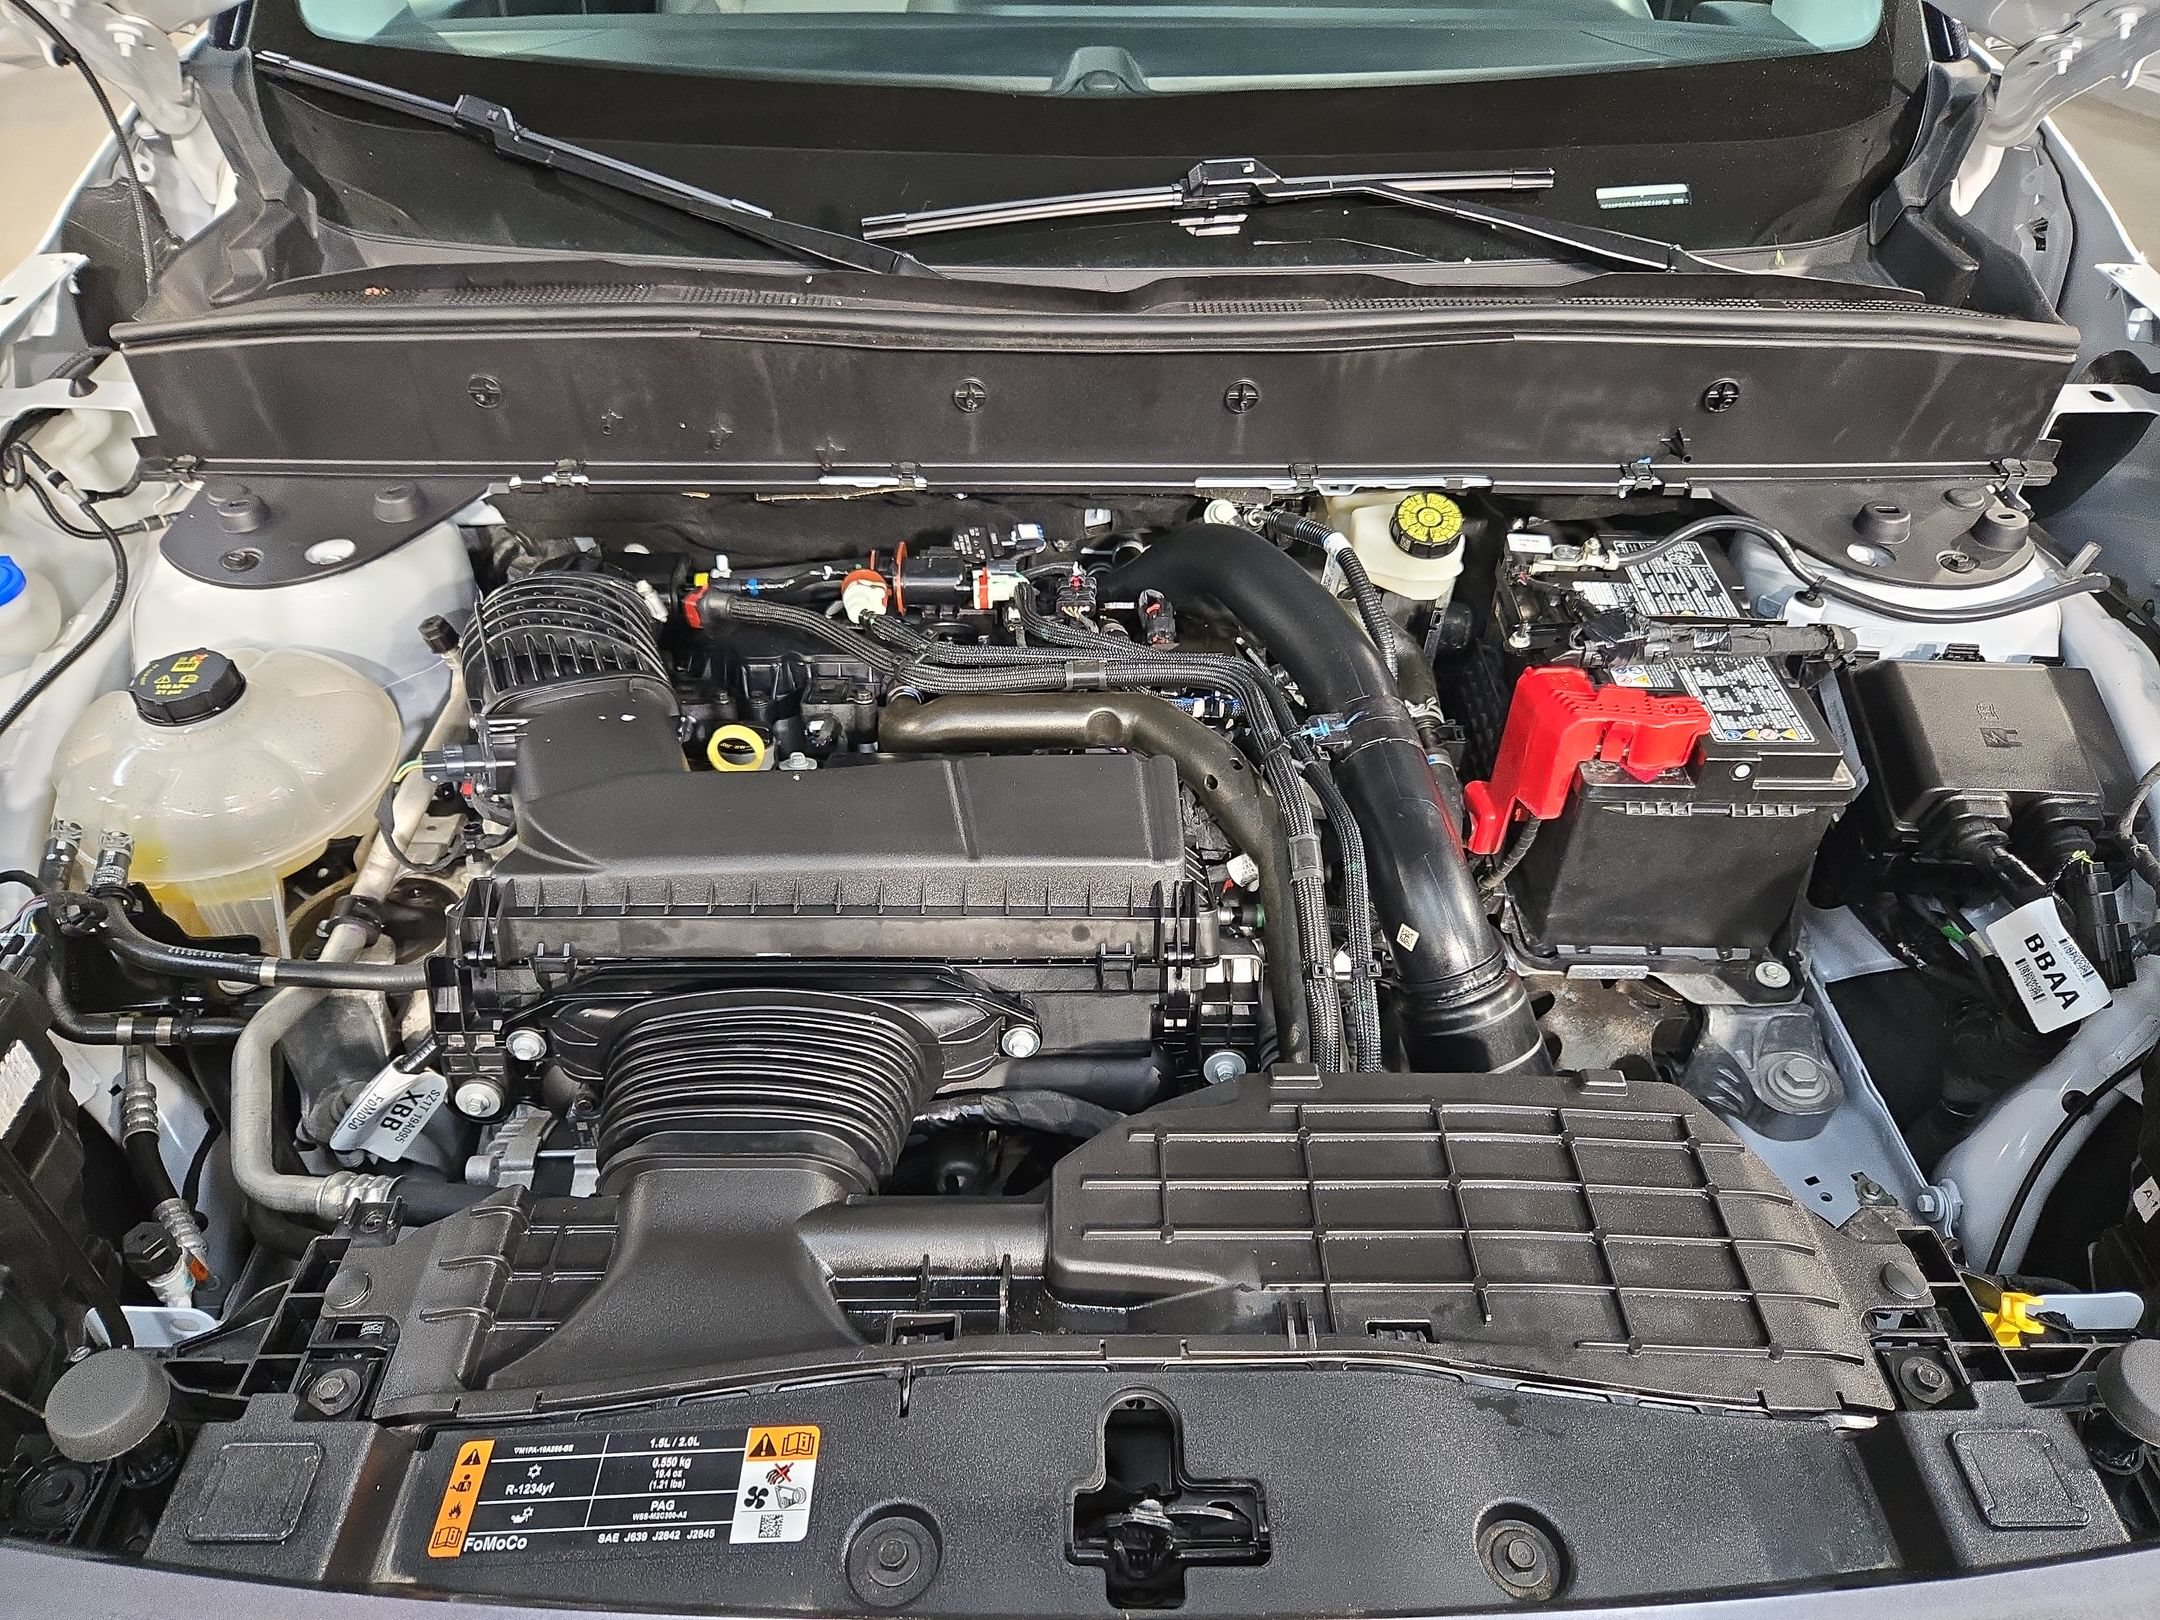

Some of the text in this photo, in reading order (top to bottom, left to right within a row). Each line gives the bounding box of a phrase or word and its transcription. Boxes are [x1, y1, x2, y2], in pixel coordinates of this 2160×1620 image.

[2024, 932, 2081, 1011] BBAA
[380, 1090, 425, 1131] XBB
[395, 1113, 422, 1144] 19A095
[678, 1436, 700, 1447] 2.0L
[652, 1456, 692, 1469] 0.550 kg
[655, 1469, 683, 1479] 19.4 oz
[505, 1481, 555, 1496] R-1234yf
[649, 1479, 686, 1491] (1.21 lbs)
[650, 1500, 675, 1511] PAG
[598, 1532, 620, 1543] SAE
[624, 1531, 648, 1542] J639
[652, 1530, 681, 1541] J2842
[463, 1535, 528, 1552] FoMoCo
